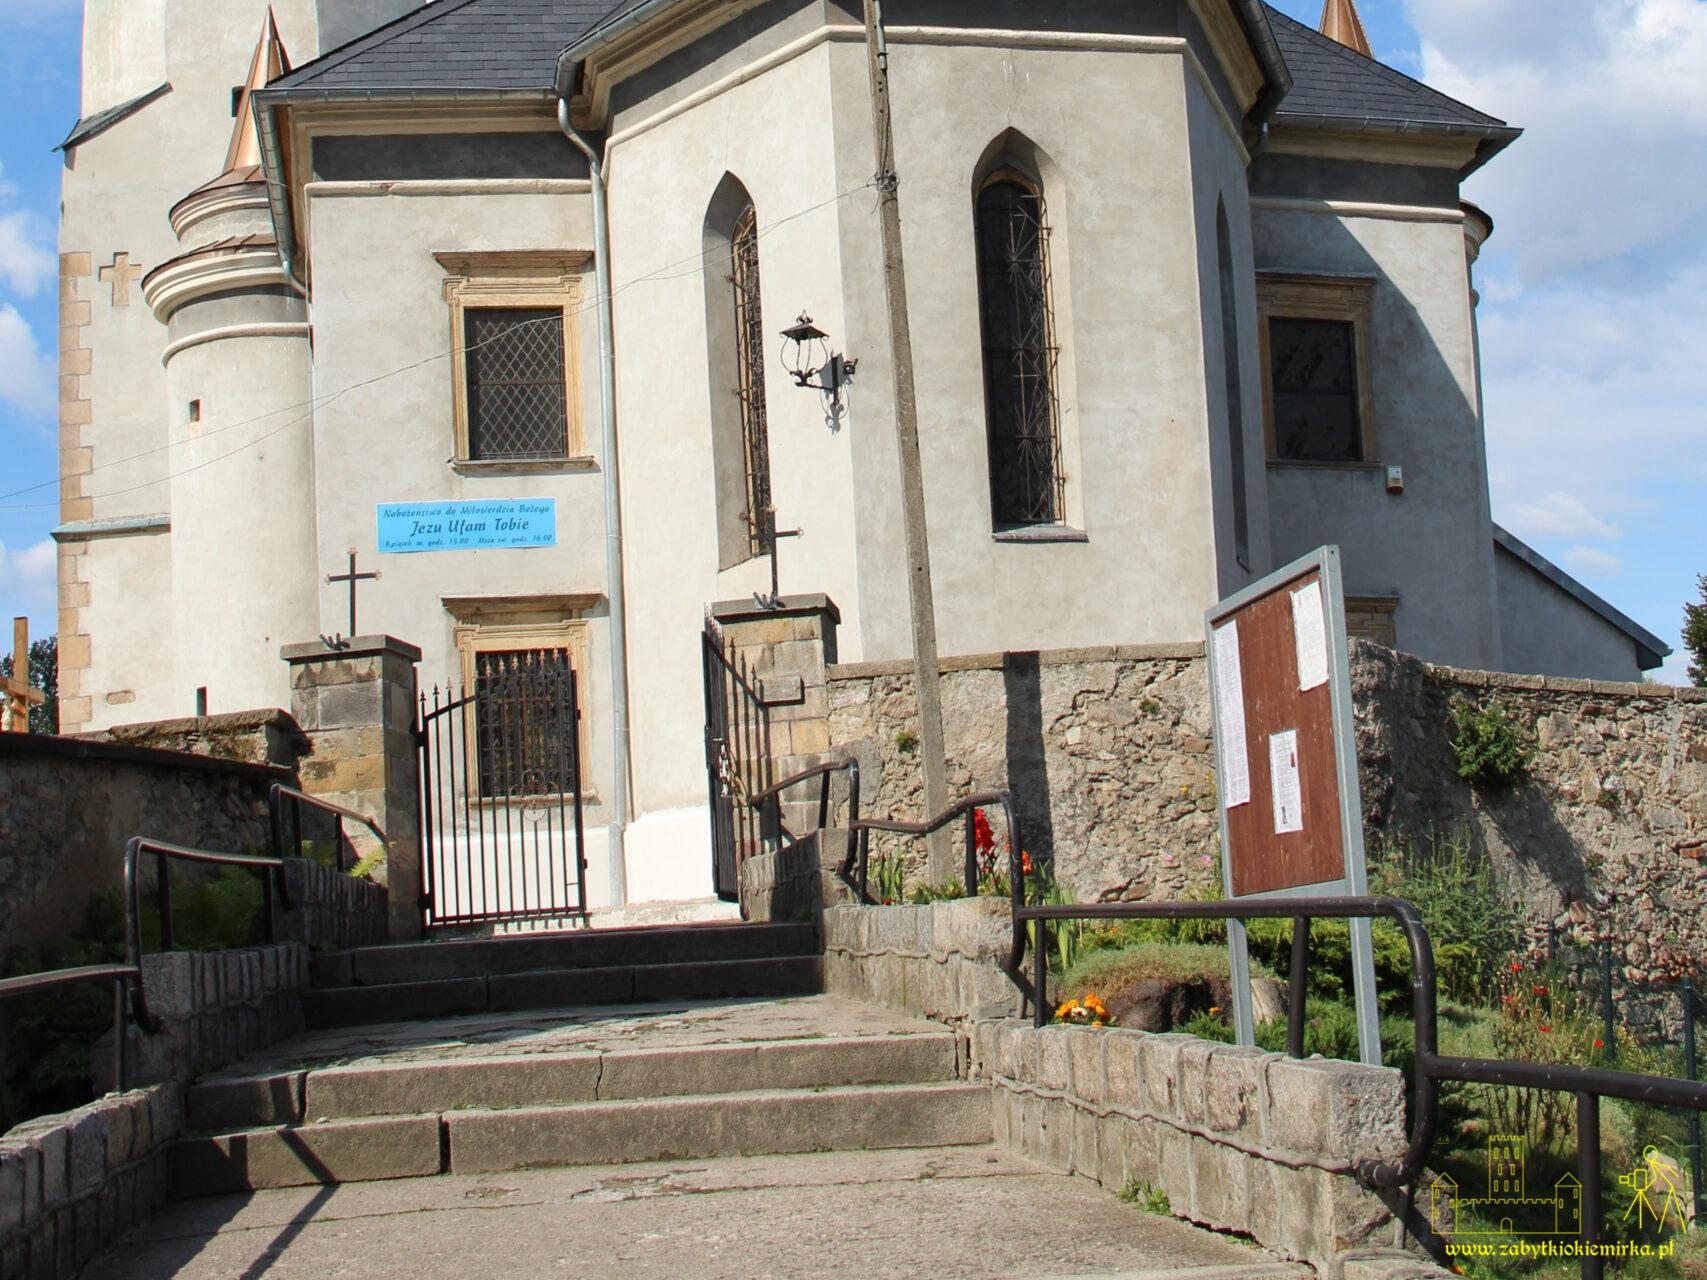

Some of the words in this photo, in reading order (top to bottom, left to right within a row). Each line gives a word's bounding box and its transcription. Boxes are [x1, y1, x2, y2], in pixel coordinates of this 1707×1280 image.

[445, 507, 457, 515] do
[410, 520, 442, 538] Jezu
[448, 519, 486, 536] Ufam
[494, 517, 530, 531] Tobie
